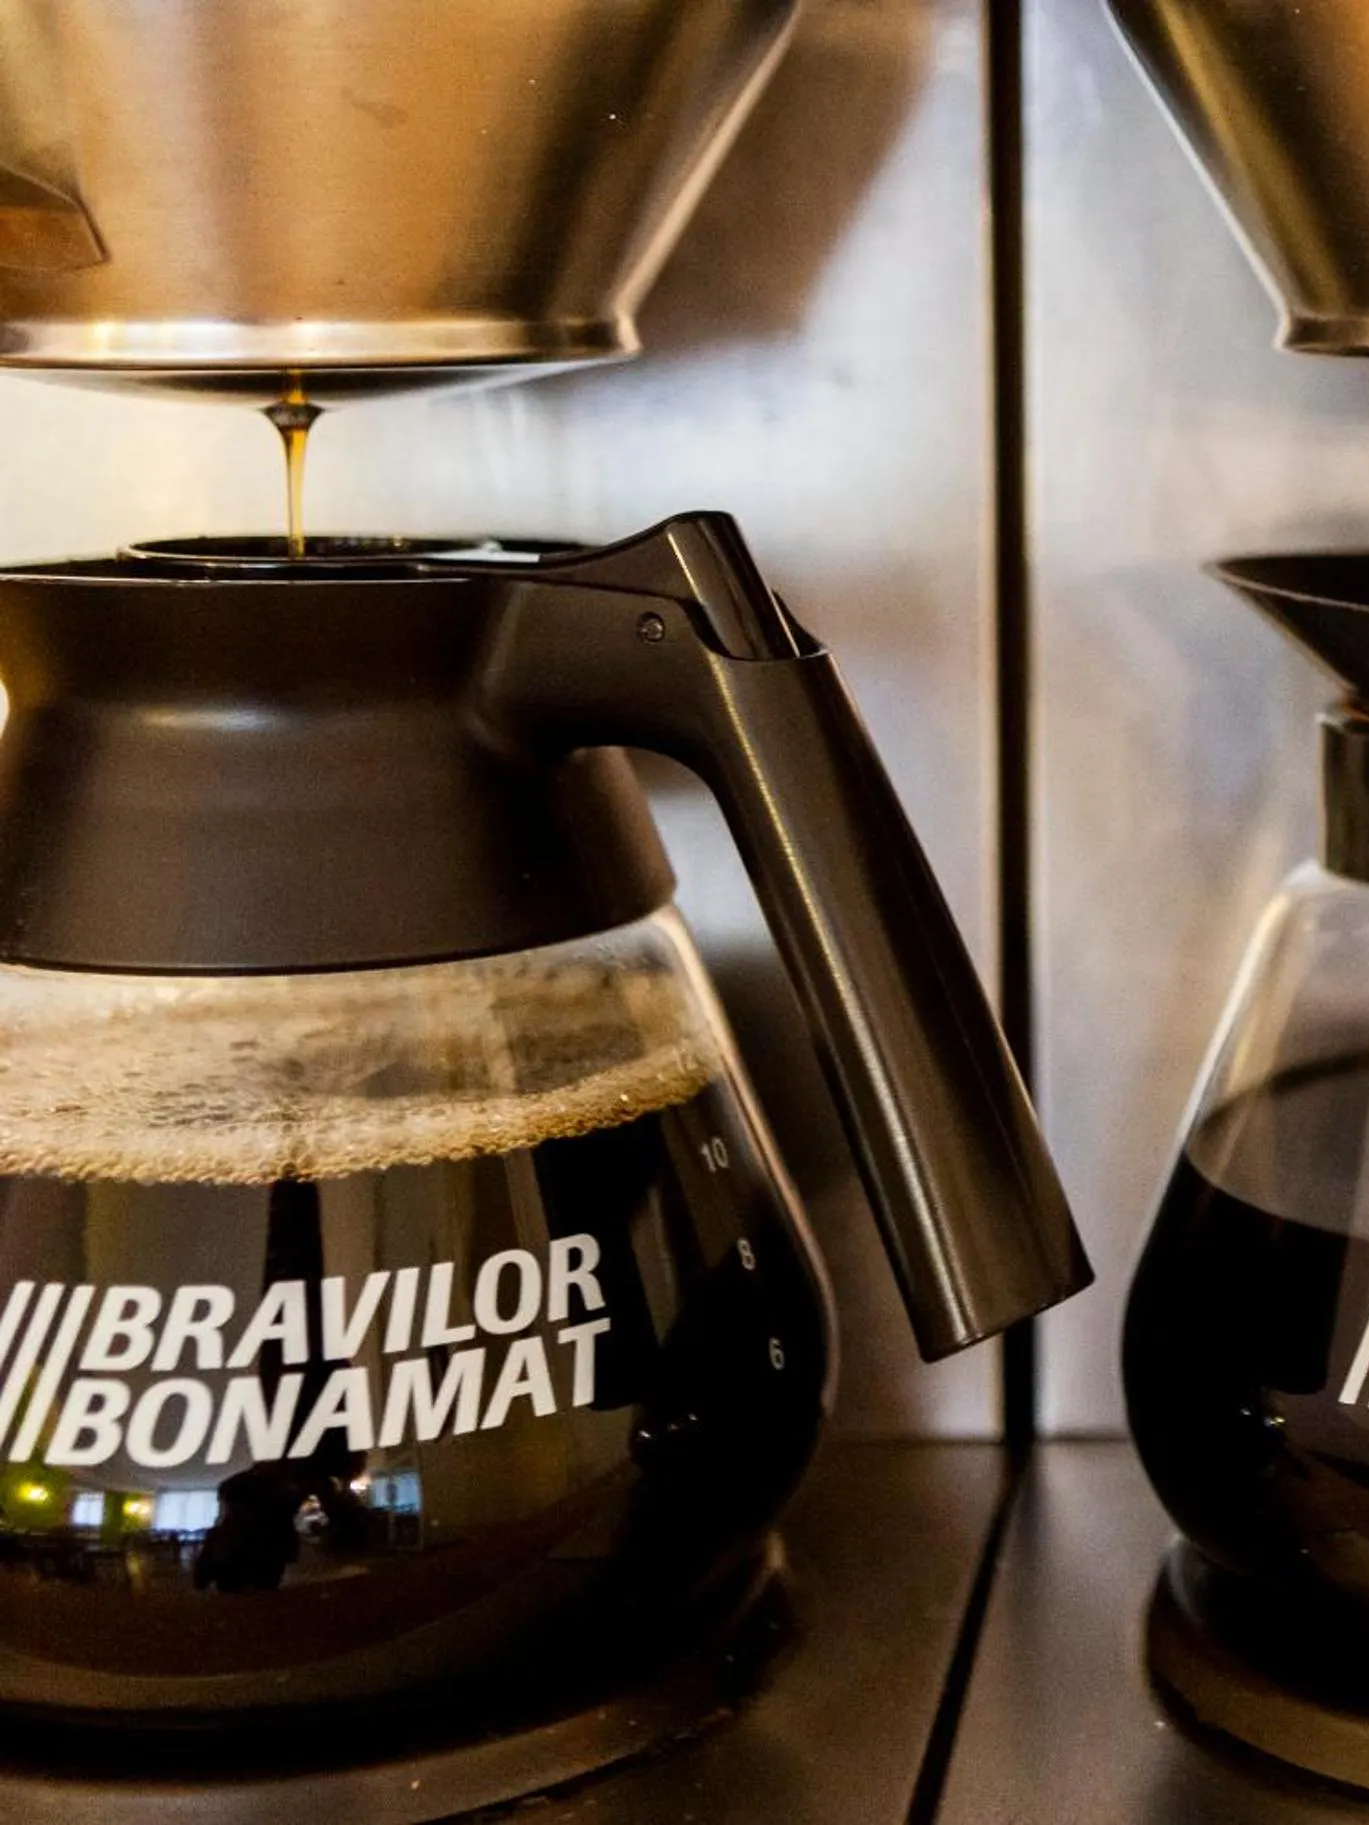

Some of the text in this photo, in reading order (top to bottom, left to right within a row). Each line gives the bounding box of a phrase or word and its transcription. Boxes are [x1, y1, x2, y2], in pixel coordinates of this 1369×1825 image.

[700, 1136, 731, 1173] 10
[736, 1236, 757, 1272] 8
[77, 1233, 606, 1373] BRAVILOR
[768, 1336, 786, 1371] 6
[43, 1317, 611, 1470] BONAMAT
